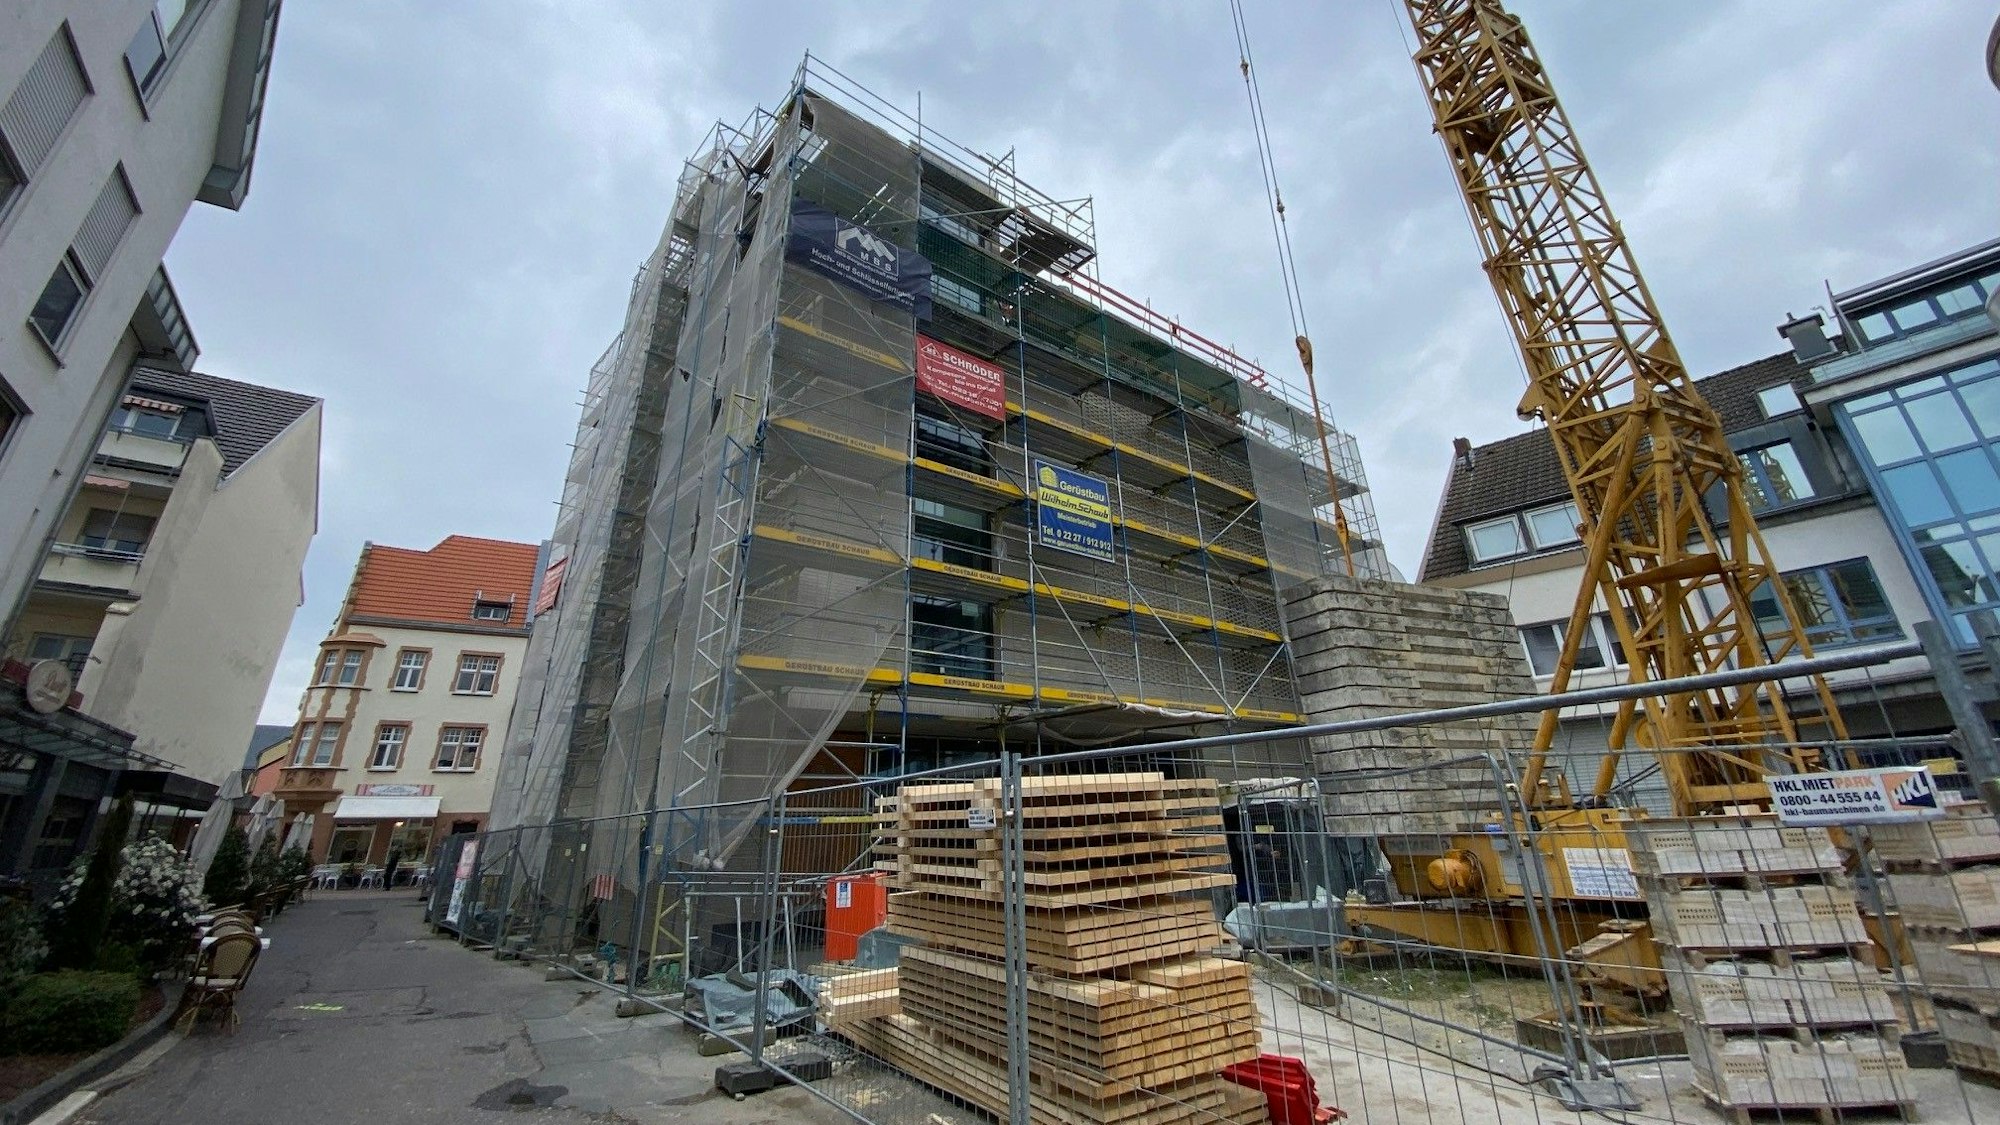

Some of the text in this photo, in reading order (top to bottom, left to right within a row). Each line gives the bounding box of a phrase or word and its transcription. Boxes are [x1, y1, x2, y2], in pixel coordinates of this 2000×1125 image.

[811, 247, 835, 263] Hoch-
[836, 260, 850, 272] und
[942, 352, 1001, 382] SCHRÖDER
[1059, 480, 1105, 502] Gerüstbau
[1063, 531, 1072, 540] 22
[1773, 771, 1931, 805] HKL MIETPARK HKL
[1780, 795, 1811, 807] 0800
[1837, 792, 1862, 804] 555
[1864, 790, 1882, 802] 44
